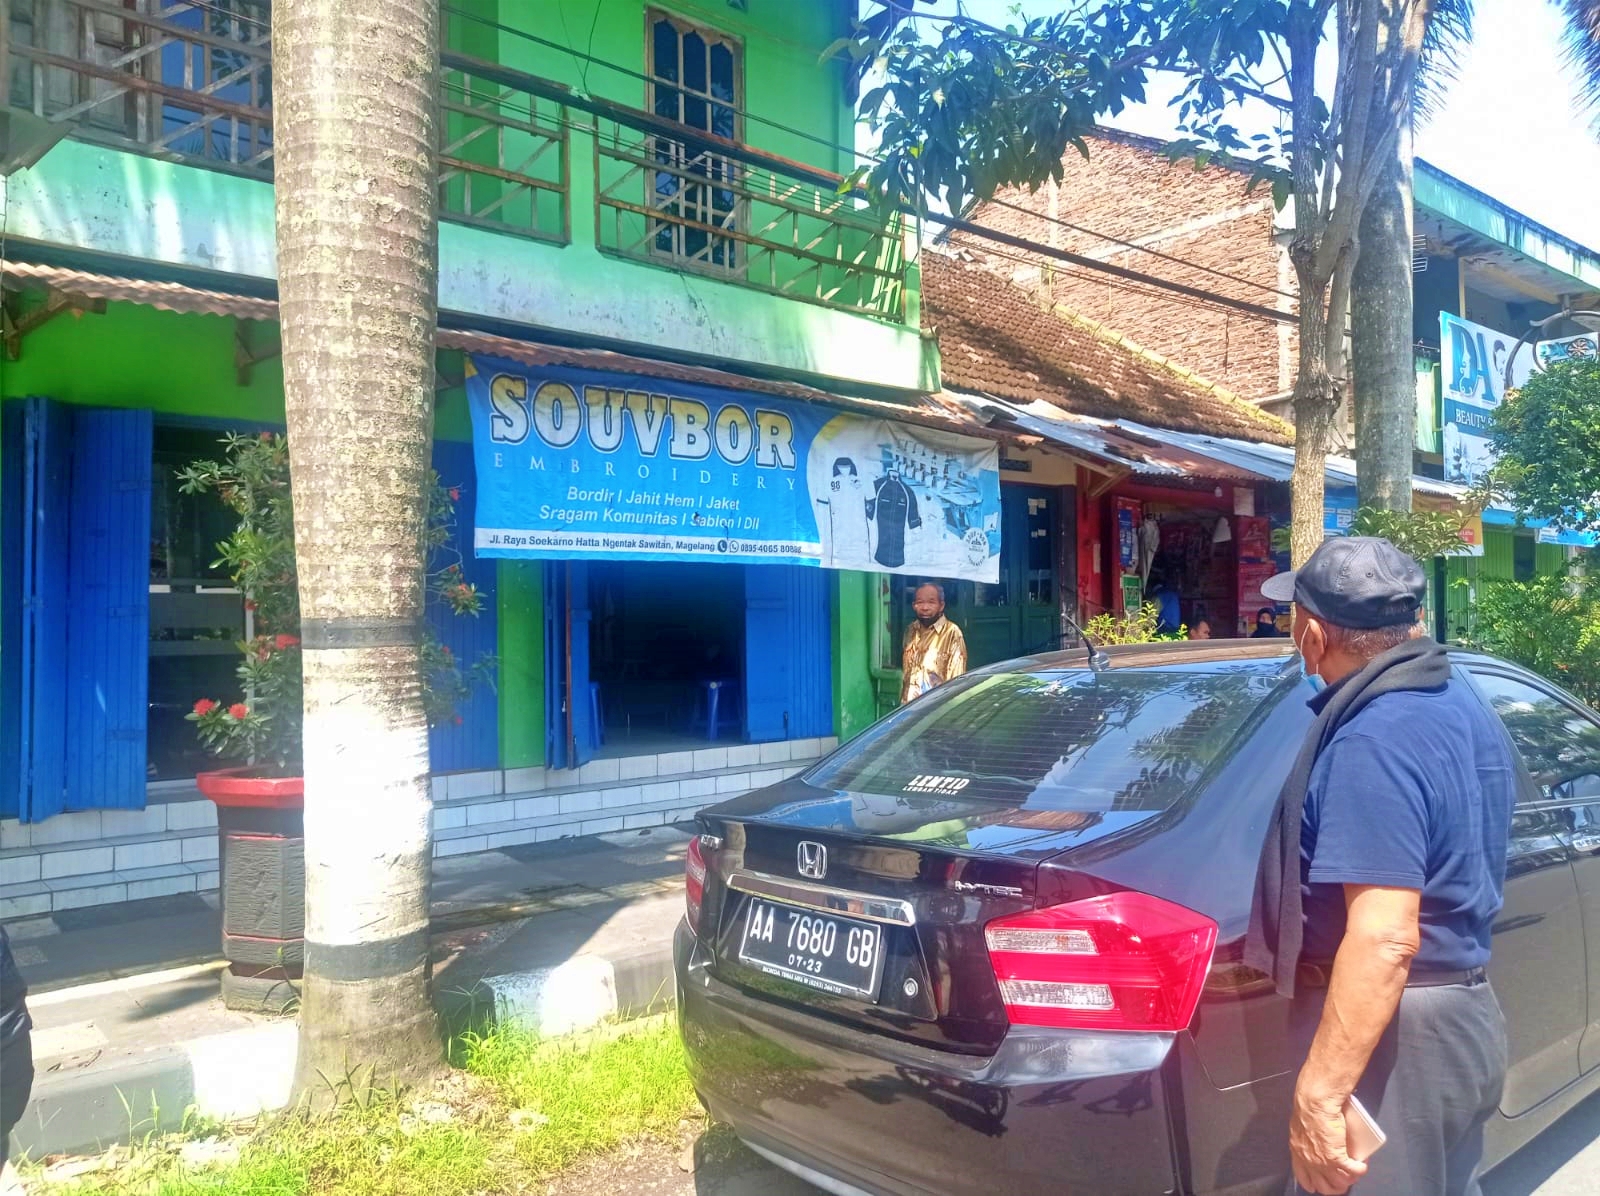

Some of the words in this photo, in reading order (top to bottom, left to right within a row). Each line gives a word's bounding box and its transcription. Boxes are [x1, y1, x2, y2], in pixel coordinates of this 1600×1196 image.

[489, 373, 797, 471] SOUVBOR
[1455, 408, 1486, 429] BEAUTY
[493, 452, 797, 491] EMBROIDERY
[567, 485, 615, 502] Bordir
[625, 489, 660, 506] Jahit
[664, 493, 695, 508] Hem
[706, 496, 740, 511] Jaket
[539, 504, 598, 524] Sragam
[602, 507, 678, 526] Komunitas
[690, 513, 735, 530] Sablon
[489, 534, 500, 545] Jl.
[503, 535, 527, 547] Raya
[529, 536, 573, 546] Soekarno
[575, 537, 600, 547] Hatta
[602, 538, 636, 550] Ngentak
[638, 540, 674, 550] Sawitan,
[675, 541, 715, 552] Magelang
[749, 904, 776, 943] AA
[787, 912, 837, 957] 7680
[846, 927, 875, 968] GB
